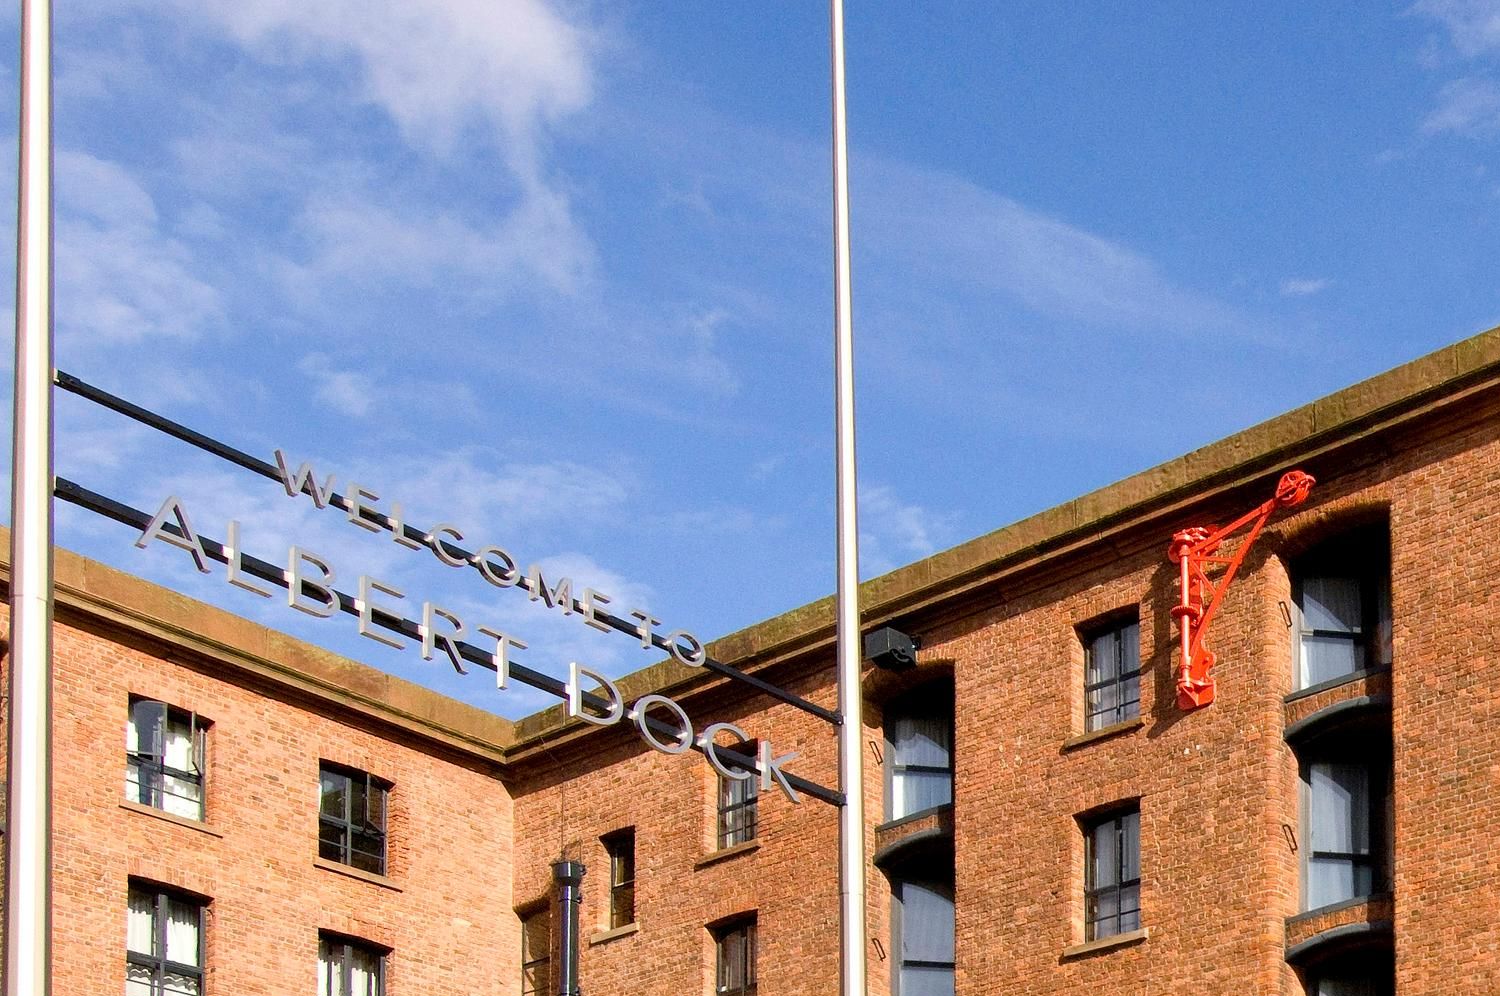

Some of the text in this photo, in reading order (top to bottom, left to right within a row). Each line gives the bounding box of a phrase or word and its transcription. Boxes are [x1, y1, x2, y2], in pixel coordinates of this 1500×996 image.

[134, 496, 802, 803] ALBERT DOCK
[273, 449, 707, 668] WELCOME TO
